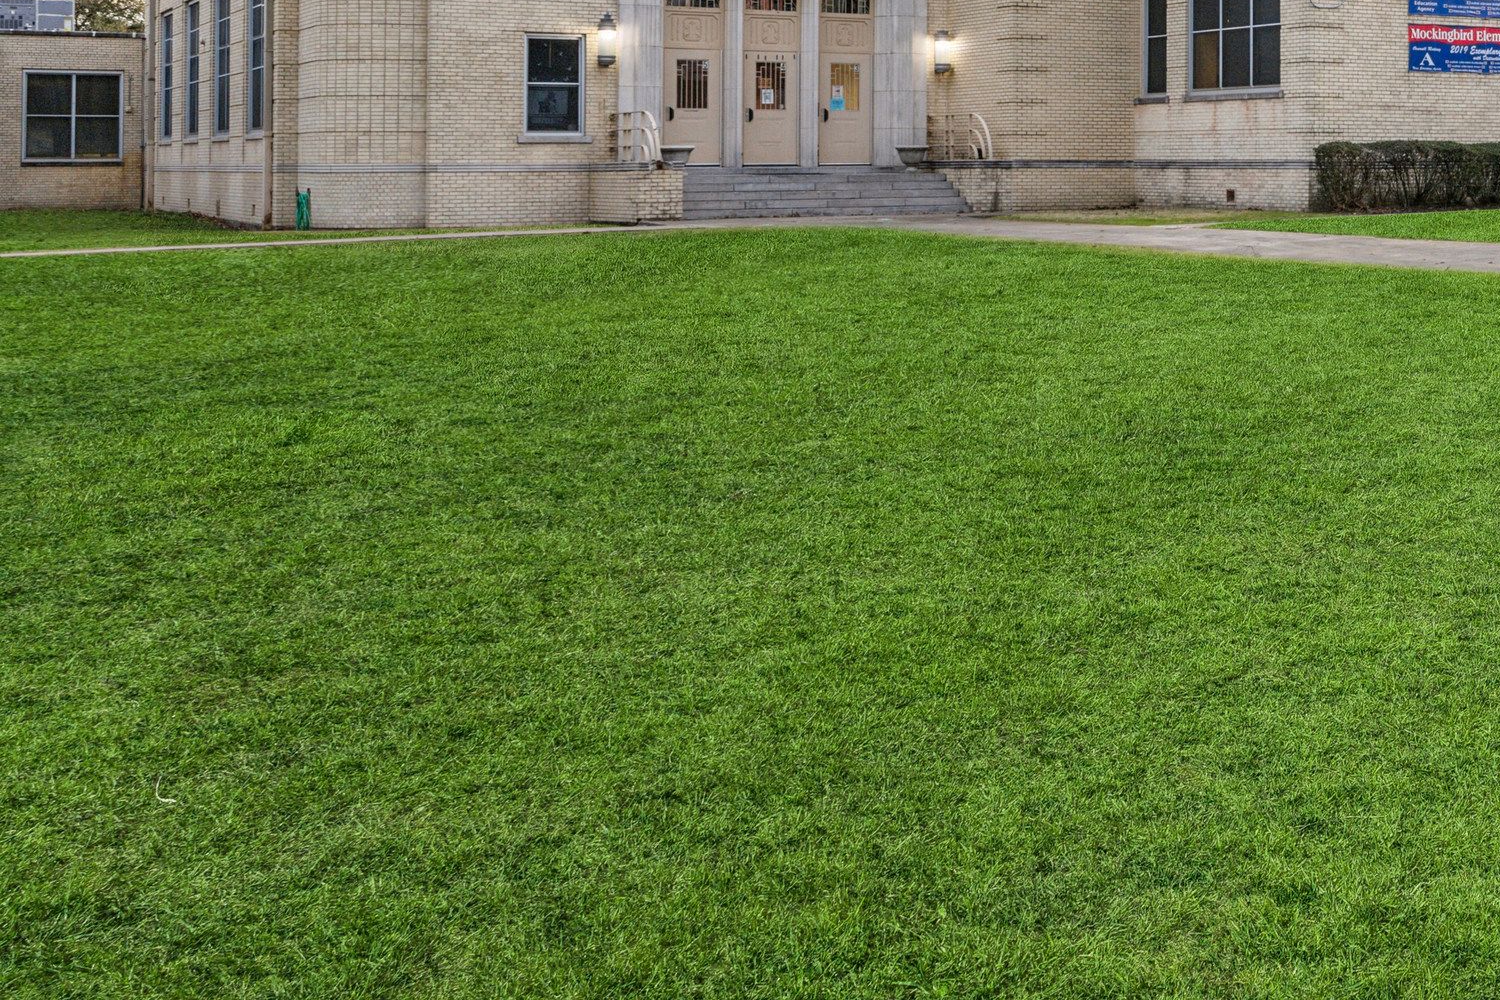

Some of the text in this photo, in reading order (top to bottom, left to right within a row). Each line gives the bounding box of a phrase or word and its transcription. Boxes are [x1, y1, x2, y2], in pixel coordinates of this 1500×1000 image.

[1411, 28, 1474, 42] Mockingbird
[1450, 45, 1469, 54] 2019
[1419, 52, 1436, 66] A
[703, 60, 710, 70] 5
[854, 64, 860, 73] 3
